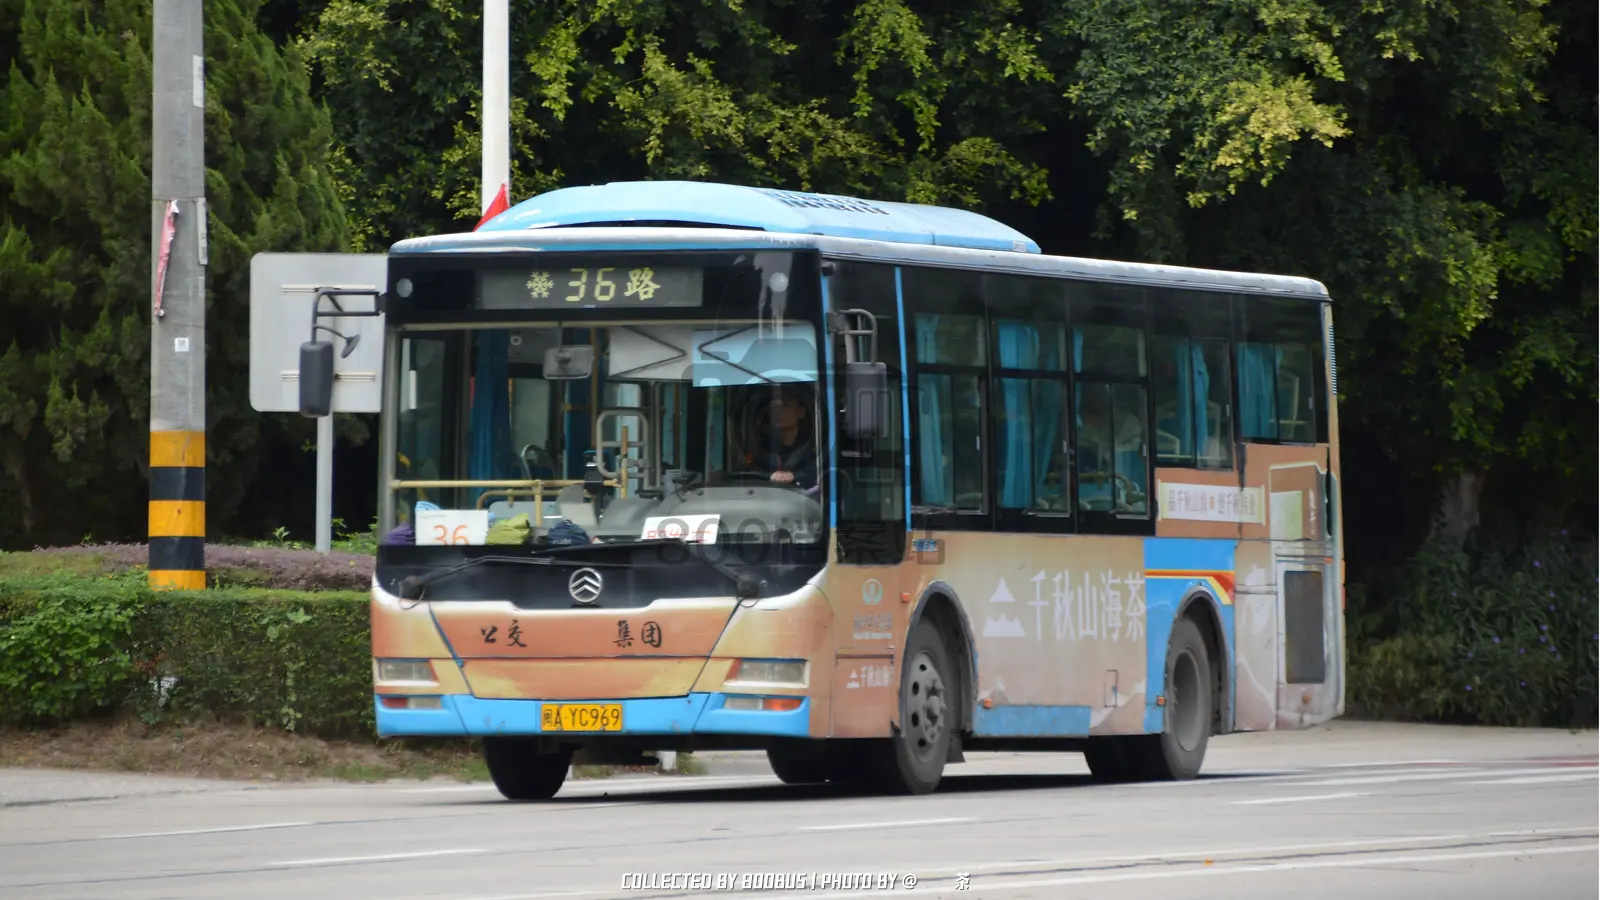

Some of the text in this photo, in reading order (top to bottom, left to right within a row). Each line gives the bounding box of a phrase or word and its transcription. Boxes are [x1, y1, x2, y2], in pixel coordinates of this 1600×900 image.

[565, 267, 661, 302] 36路
[433, 524, 470, 545] 36
[1027, 568, 1147, 643] 千秋山海茶
[480, 619, 663, 648] 公交 集团
